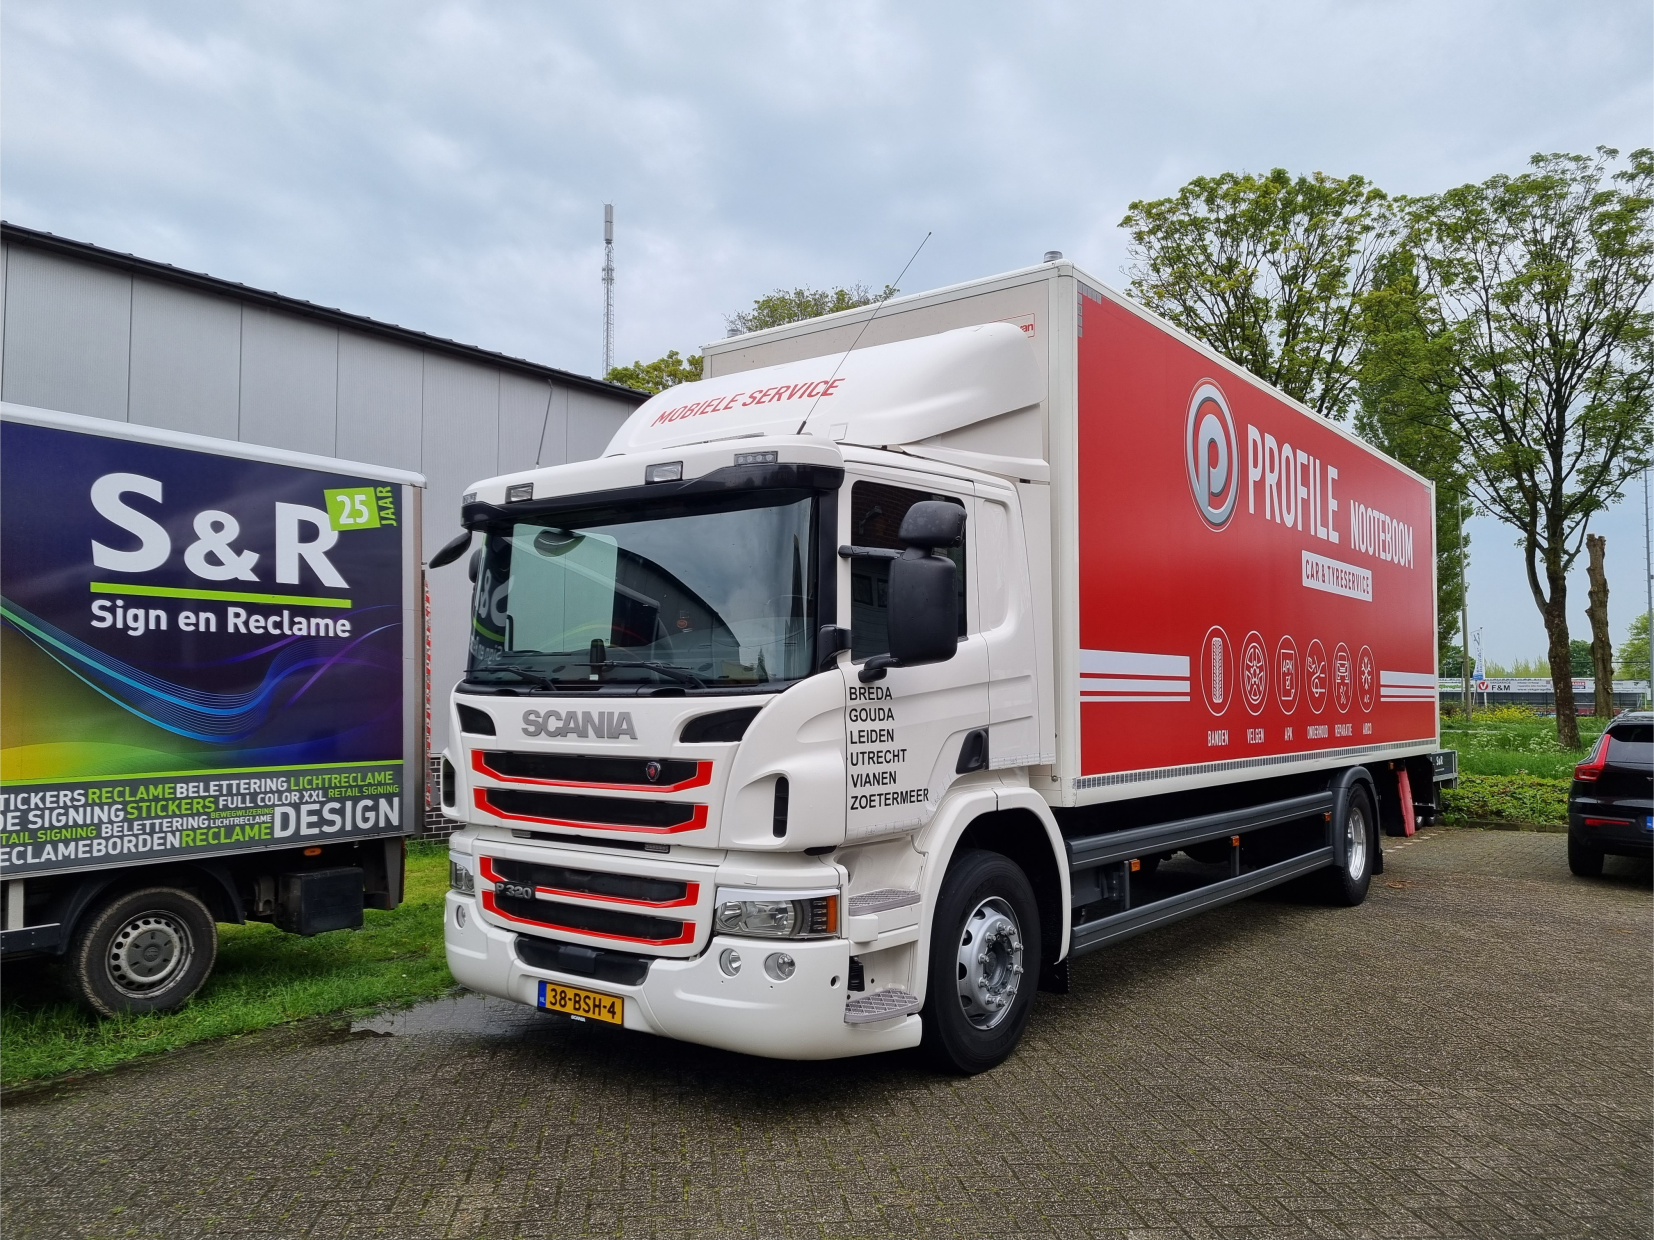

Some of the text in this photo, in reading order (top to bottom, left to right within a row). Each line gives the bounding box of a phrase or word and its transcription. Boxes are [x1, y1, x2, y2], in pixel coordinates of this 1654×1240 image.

[651, 378, 845, 427] MOBIELE SERVICE
[376, 486, 397, 527] JAAR
[1248, 424, 1413, 569] PROFILE NOOTEBOOM
[336, 495, 369, 524] 25
[1305, 559, 1370, 594] CAR & TYRESERVICE
[90, 599, 351, 638] Sign en Reclame
[1282, 659, 1294, 673] APK
[849, 687, 893, 701] BREDA
[521, 709, 638, 739] SCANIA
[849, 708, 895, 722] GOUDA
[850, 729, 894, 744] LEIDEN
[1207, 729, 1229, 747] BANDEN
[1246, 728, 1265, 744] VELGEN
[1284, 726, 1293, 741] APK
[850, 749, 907, 766] UTRECHT
[0, 771, 394, 811] TICKERS RECLAME BELETTERING LICHTRECLAME
[851, 771, 897, 788] VIANEN
[27, 804, 124, 829] SIGNING
[126, 797, 215, 819] STICKERS
[218, 795, 254, 809] FULL
[257, 791, 299, 806] COLOR
[302, 790, 326, 803] XXL
[328, 788, 361, 798] RETAIL
[362, 784, 399, 796] SIGNING
[850, 788, 929, 810] ZOETERMEER
[210, 808, 274, 819] BEWEGWIJZERING
[210, 815, 273, 827] LICHTRECLAME
[273, 797, 399, 839] DESIGN
[0, 815, 209, 845] TAIL SIGNING BELETTERING
[0, 823, 271, 867] ECLAMEBORDEN RECLAME
[496, 882, 532, 900] P 320
[549, 988, 617, 1019] 38-BSH-4
